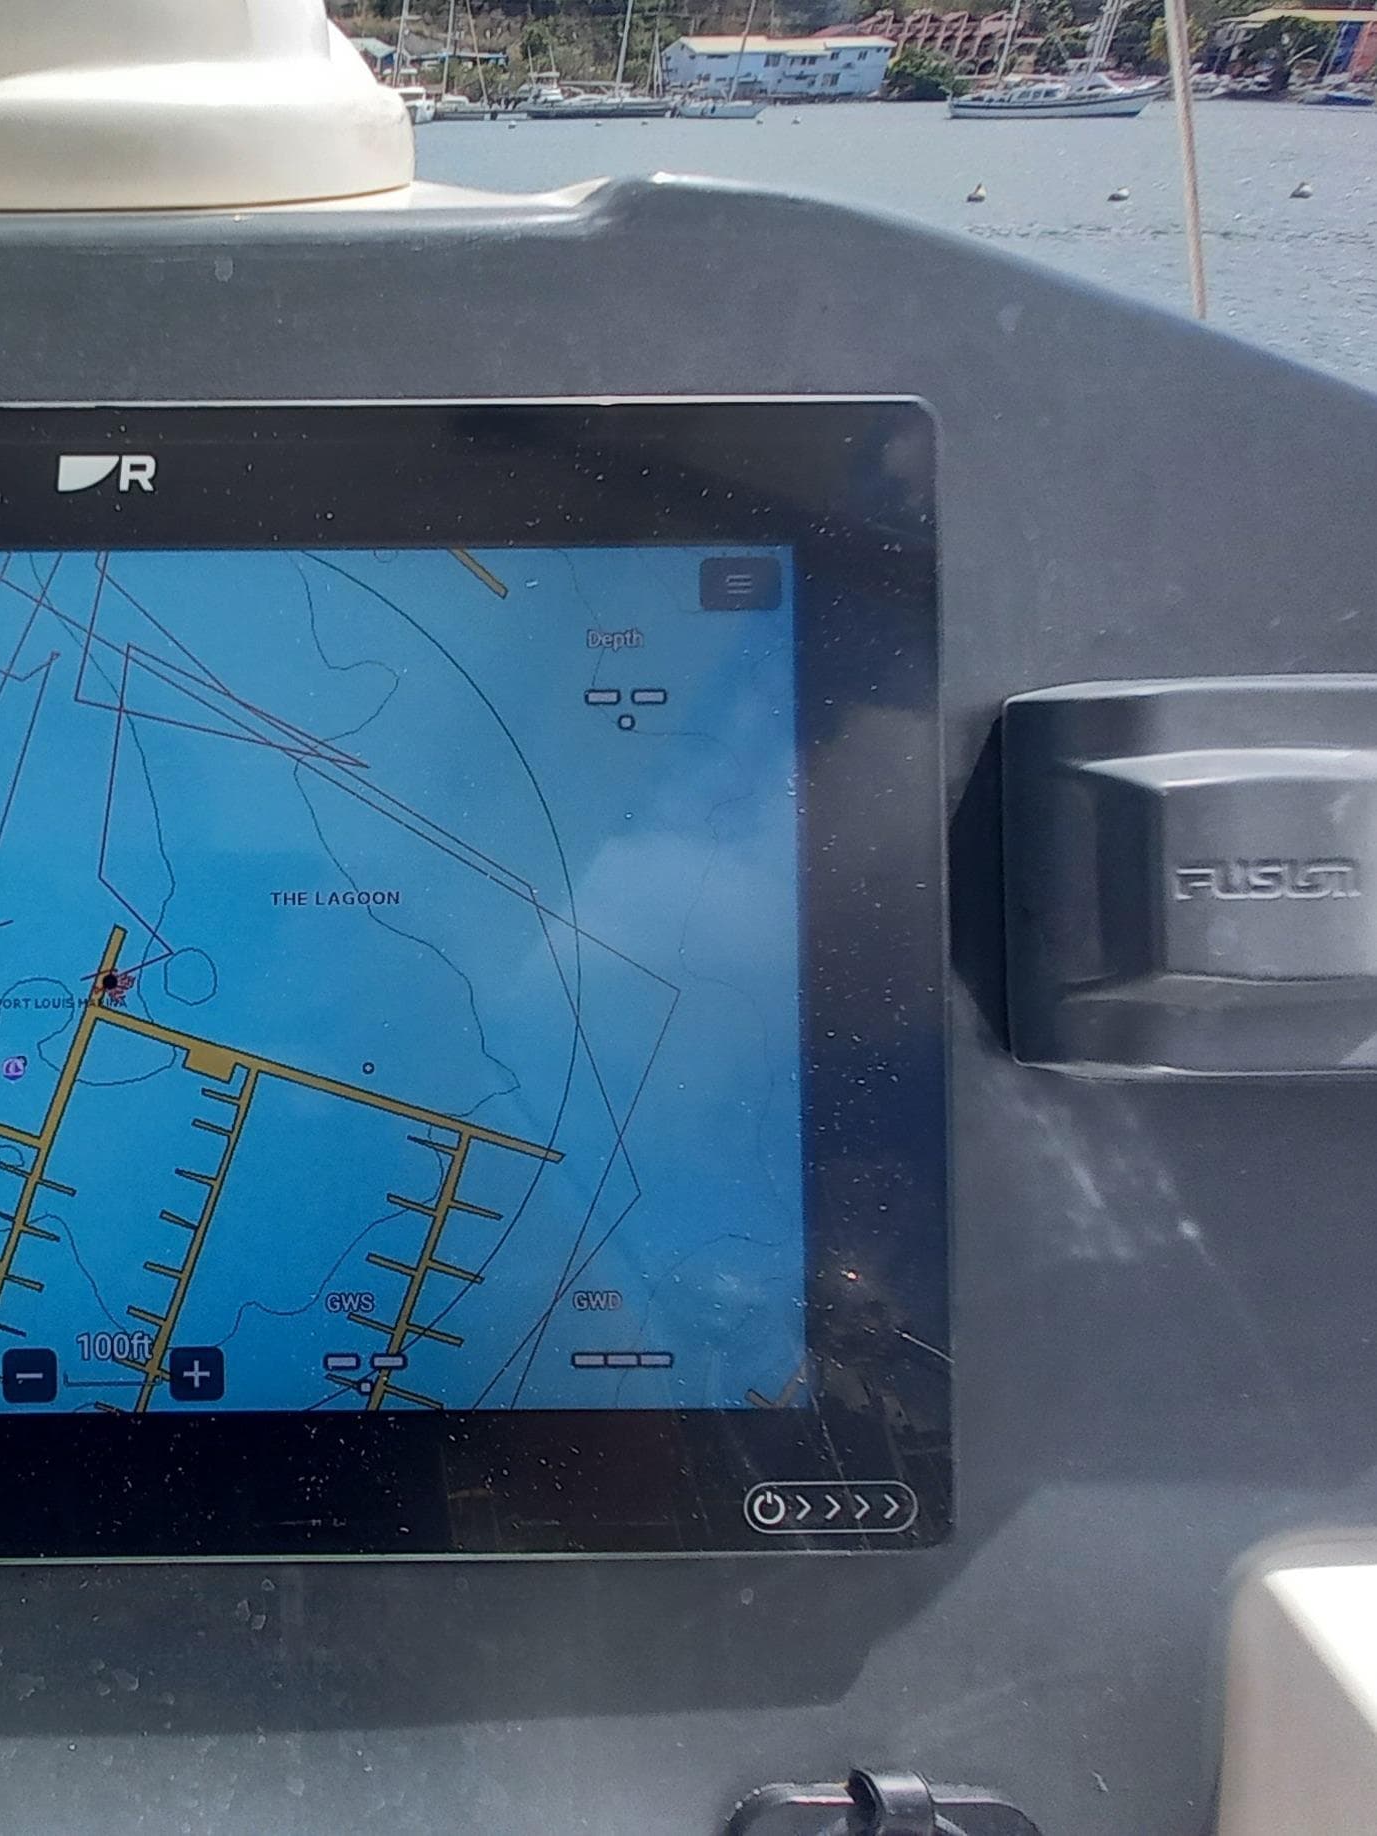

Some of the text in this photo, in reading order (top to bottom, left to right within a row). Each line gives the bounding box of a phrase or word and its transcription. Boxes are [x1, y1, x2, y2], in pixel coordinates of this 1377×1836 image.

[586, 629, 644, 653] Depth
[270, 890, 401, 907] THE LAGOON
[33, 998, 74, 1010] LOUIS
[325, 1293, 375, 1313] GWS
[573, 1291, 622, 1311] GWD
